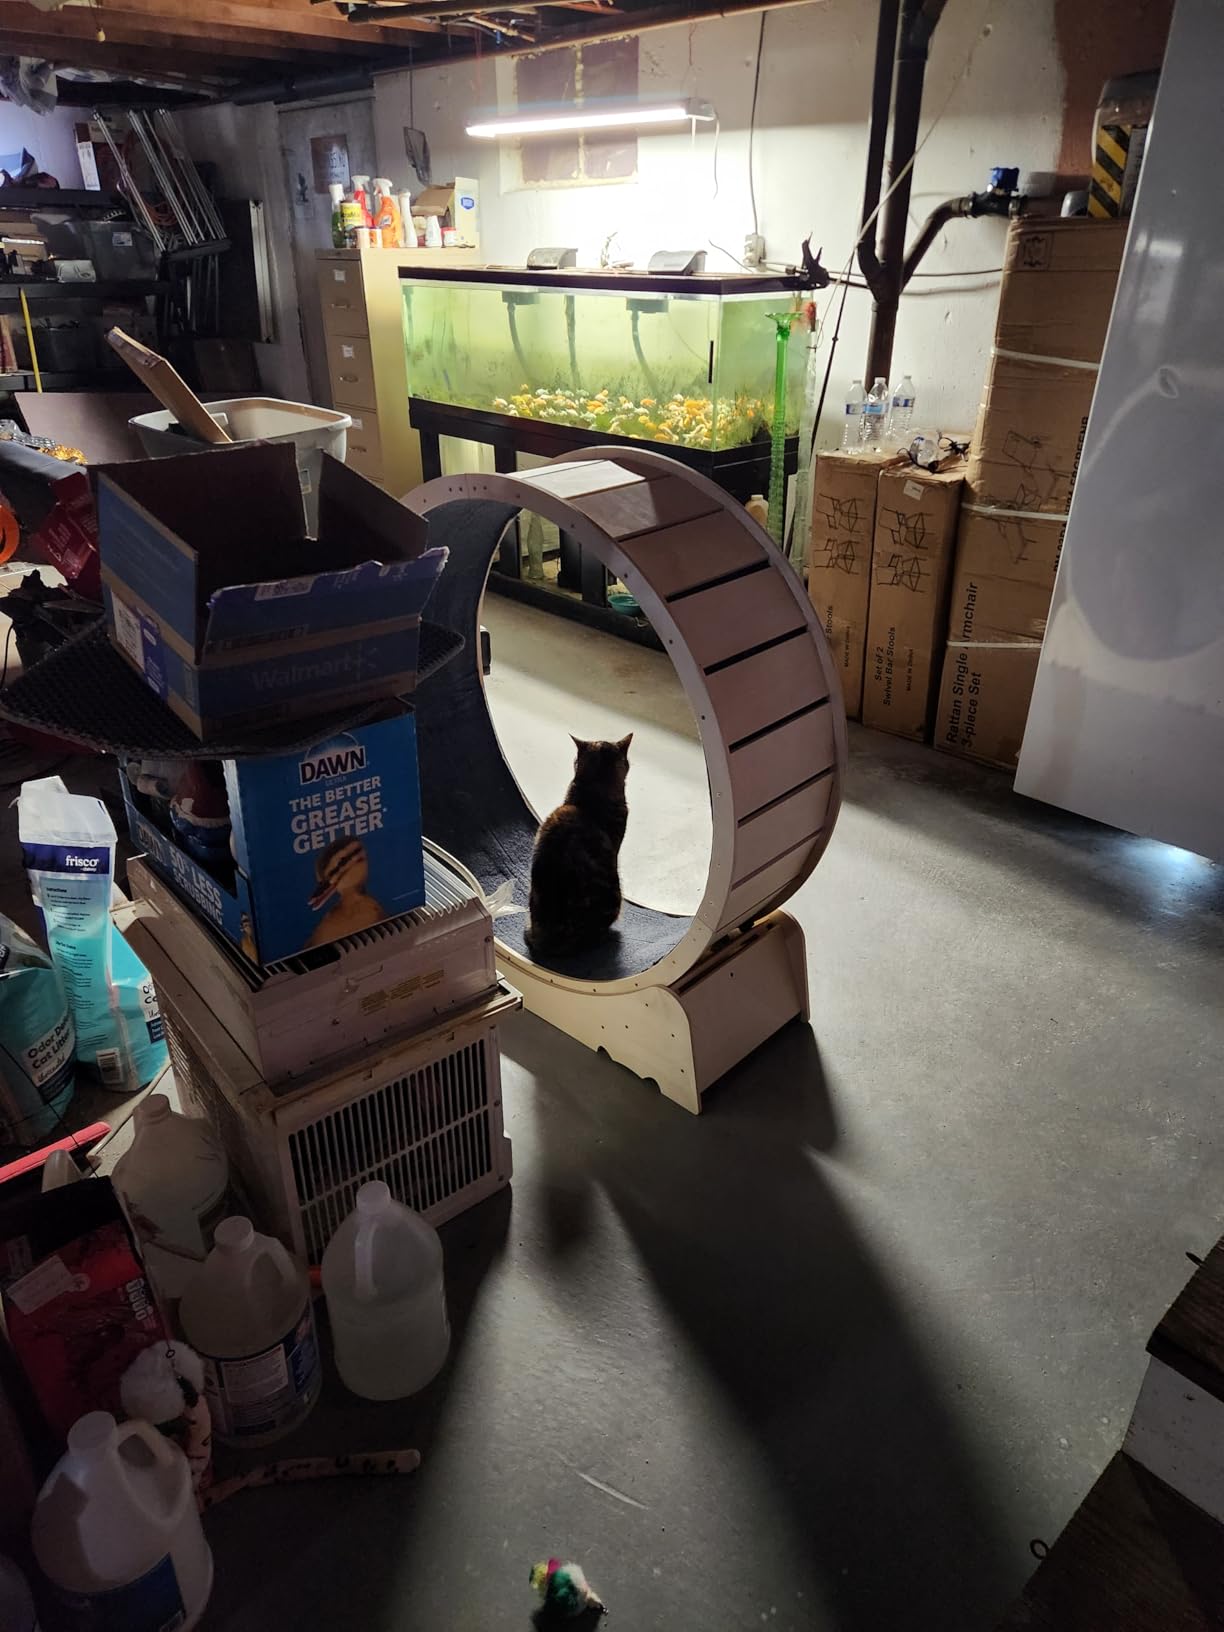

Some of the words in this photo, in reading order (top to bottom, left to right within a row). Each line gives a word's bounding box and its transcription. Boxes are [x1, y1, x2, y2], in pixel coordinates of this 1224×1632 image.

[875, 646, 884, 654] 2
[885, 627, 897, 657] Stools
[250, 653, 353, 690] Walmart
[874, 653, 883, 665] of
[874, 665, 883, 681] Set
[884, 659, 895, 675] Bar
[952, 653, 969, 696] Single
[968, 671, 982, 696] Set
[882, 676, 894, 706] Swivel
[946, 700, 963, 744] Rattan
[960, 699, 978, 748] 3-piece
[301, 747, 366, 784] DAWN
[288, 793, 322, 813] THE
[325, 776, 382, 803] BETTER
[291, 791, 383, 834] GREASE
[293, 811, 384, 855] GETTER
[65, 855, 98, 867] frisco
[191, 866, 224, 910] LESS
[28, 1033, 56, 1059] Odor
[32, 1052, 53, 1070] Cat
